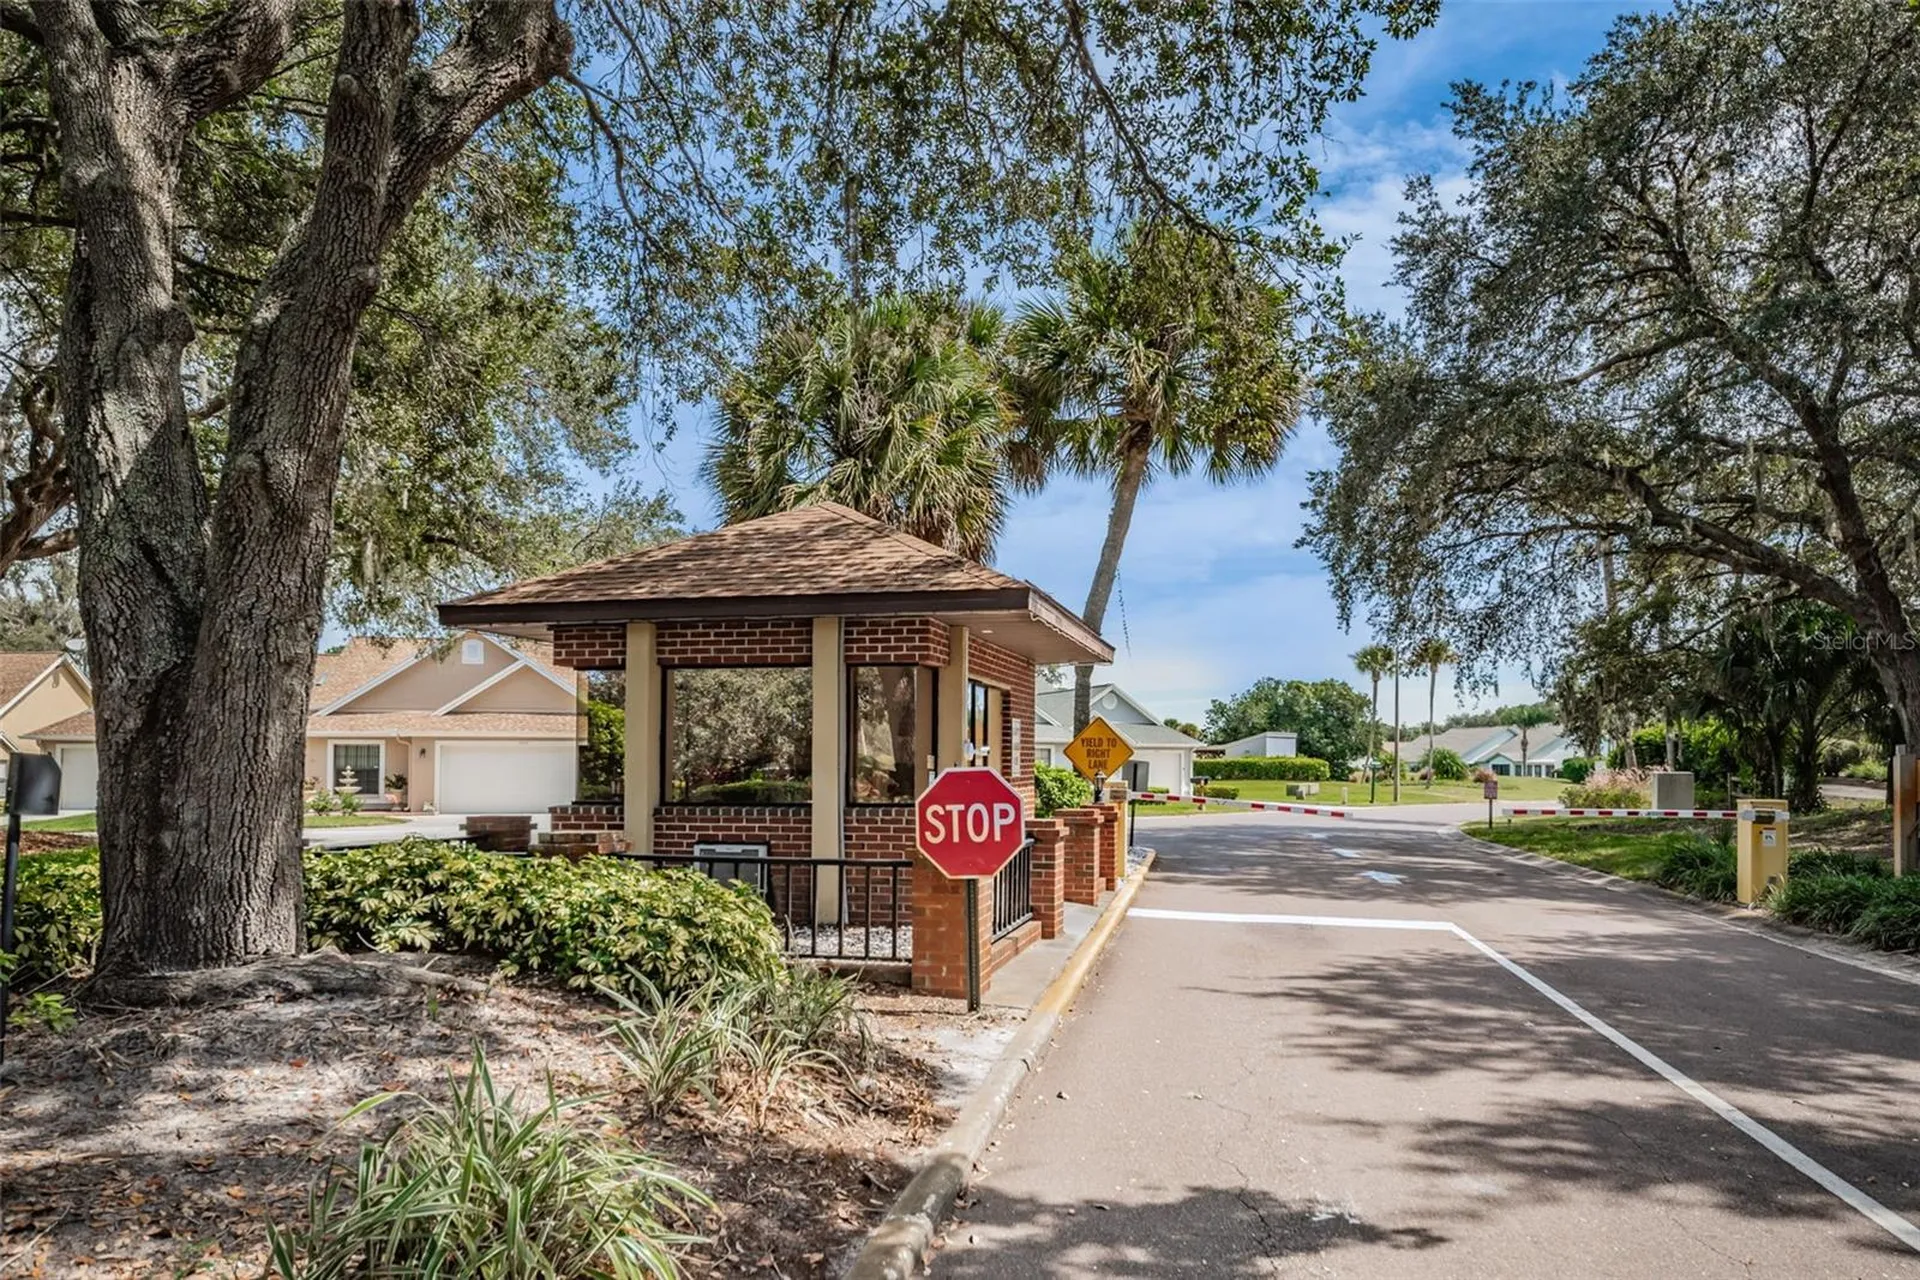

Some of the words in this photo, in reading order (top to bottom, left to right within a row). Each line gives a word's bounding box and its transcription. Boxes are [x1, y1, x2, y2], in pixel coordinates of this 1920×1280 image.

[1080, 737, 1104, 748] YIELD
[1107, 737, 1118, 748] TO
[1086, 748, 1111, 759] RIGHT
[1088, 759, 1109, 770] LANE
[924, 802, 1016, 845] STOP
